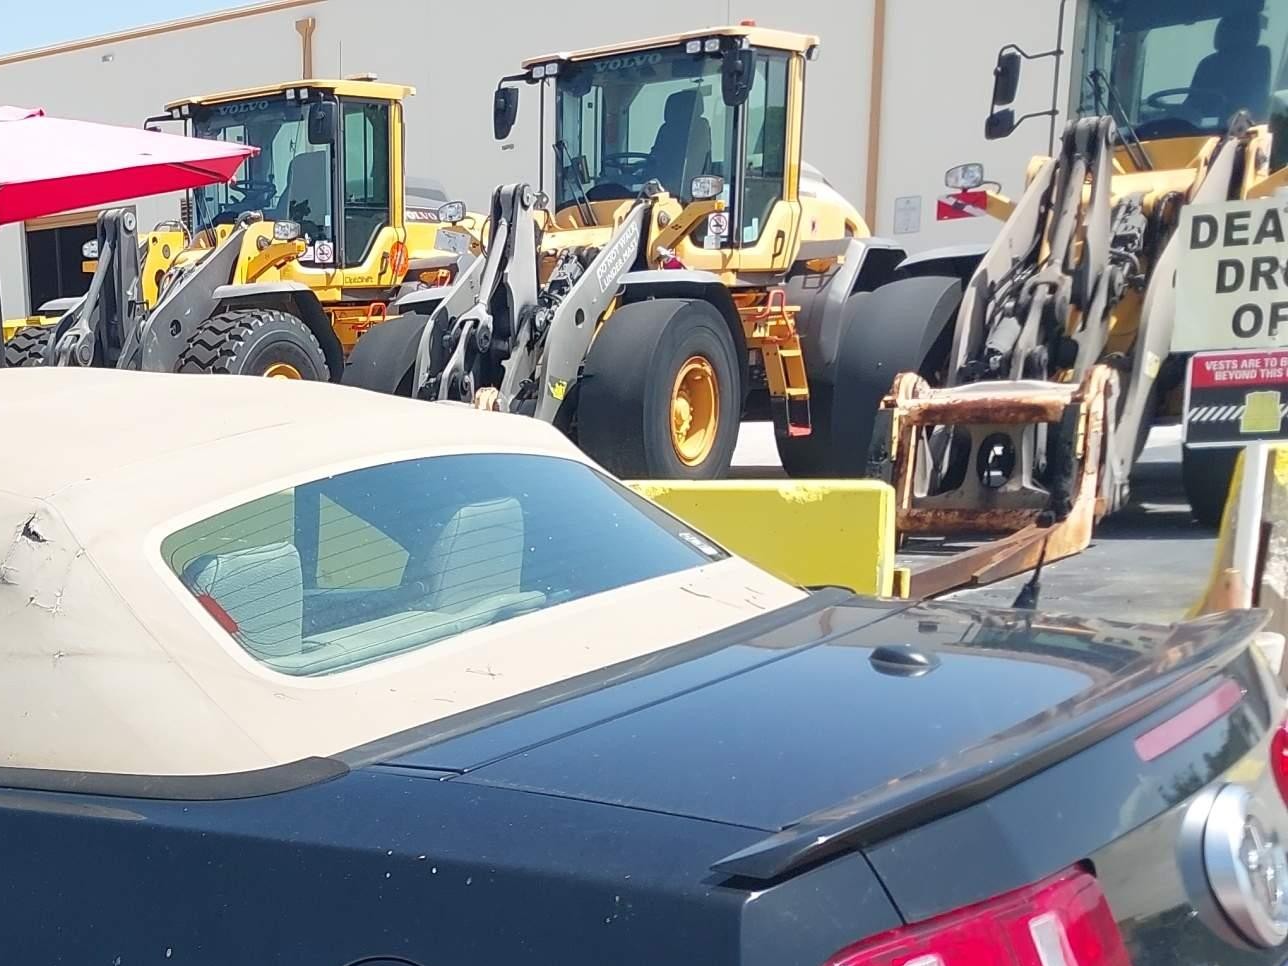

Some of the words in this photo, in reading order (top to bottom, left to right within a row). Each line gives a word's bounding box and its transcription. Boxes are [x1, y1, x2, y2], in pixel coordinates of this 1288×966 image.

[593, 53, 663, 73] VOLVO
[218, 100, 270, 116] VOLVO
[603, 257, 624, 288] UNDER
[621, 237, 638, 263] MAST
[605, 244, 619, 268] NOT
[1216, 255, 1288, 294] DR
[1204, 360, 1239, 371] VESTS
[1241, 358, 1261, 369] ARE
[1264, 357, 1278, 368] TO
[1215, 369, 1257, 380] BEYOND
[1259, 367, 1283, 379] THIS
